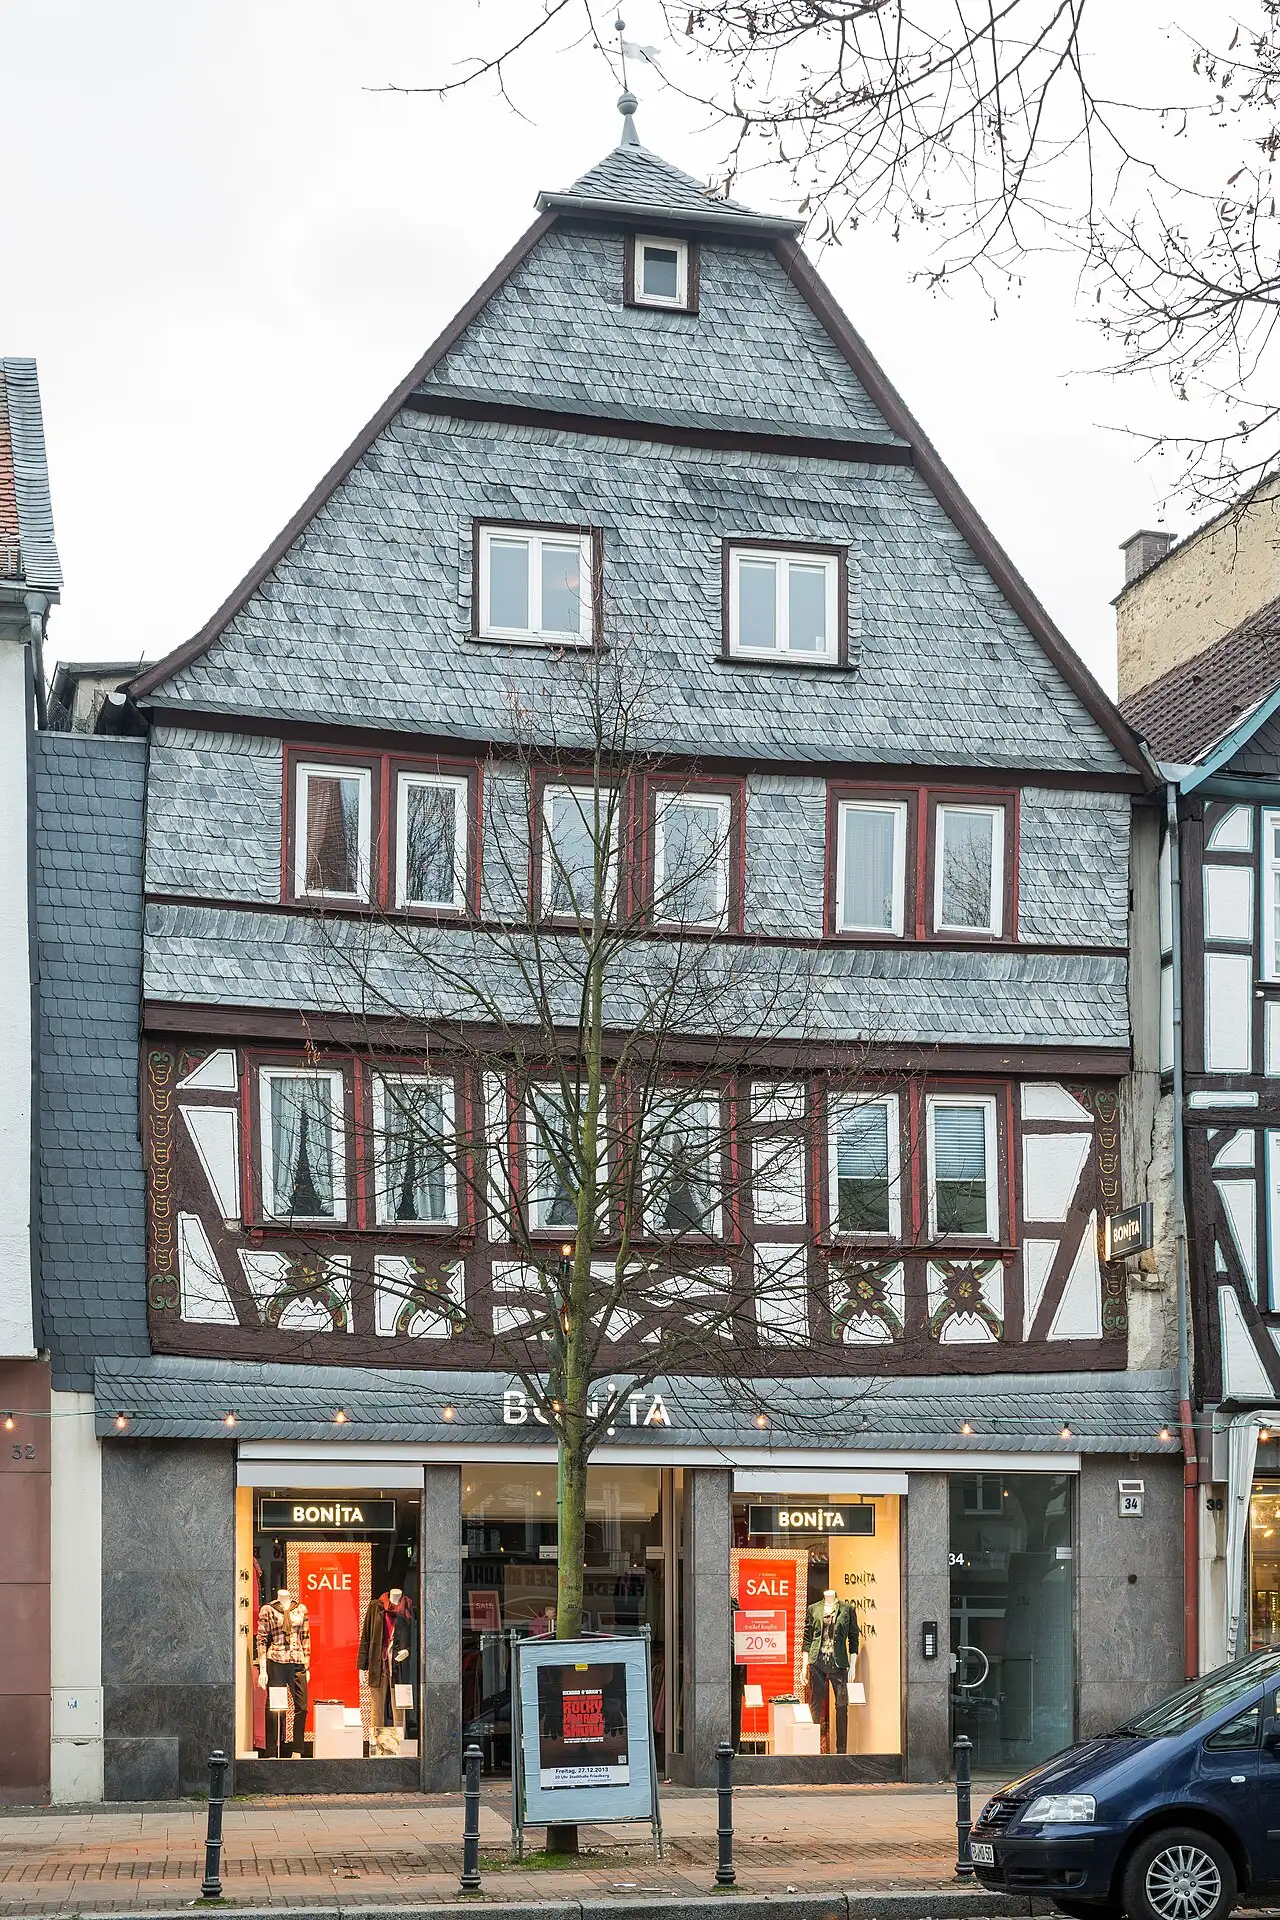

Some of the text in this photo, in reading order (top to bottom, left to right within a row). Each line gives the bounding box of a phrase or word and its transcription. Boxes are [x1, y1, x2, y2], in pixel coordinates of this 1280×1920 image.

[1113, 1219, 1140, 1243] BONITA
[12, 1443, 36, 1460] 32
[1125, 1498, 1138, 1509] 34
[293, 1503, 364, 1527] BONITA
[778, 1508, 845, 1531] BONITA
[948, 1553, 964, 1566] 34
[307, 1573, 352, 1591] SALE
[746, 1579, 789, 1596] SALE
[475, 1602, 494, 1610] SALE
[745, 1636, 777, 1650] 20%
[563, 1700, 603, 1714] ROCKY
[563, 1723, 604, 1737] SHOW
